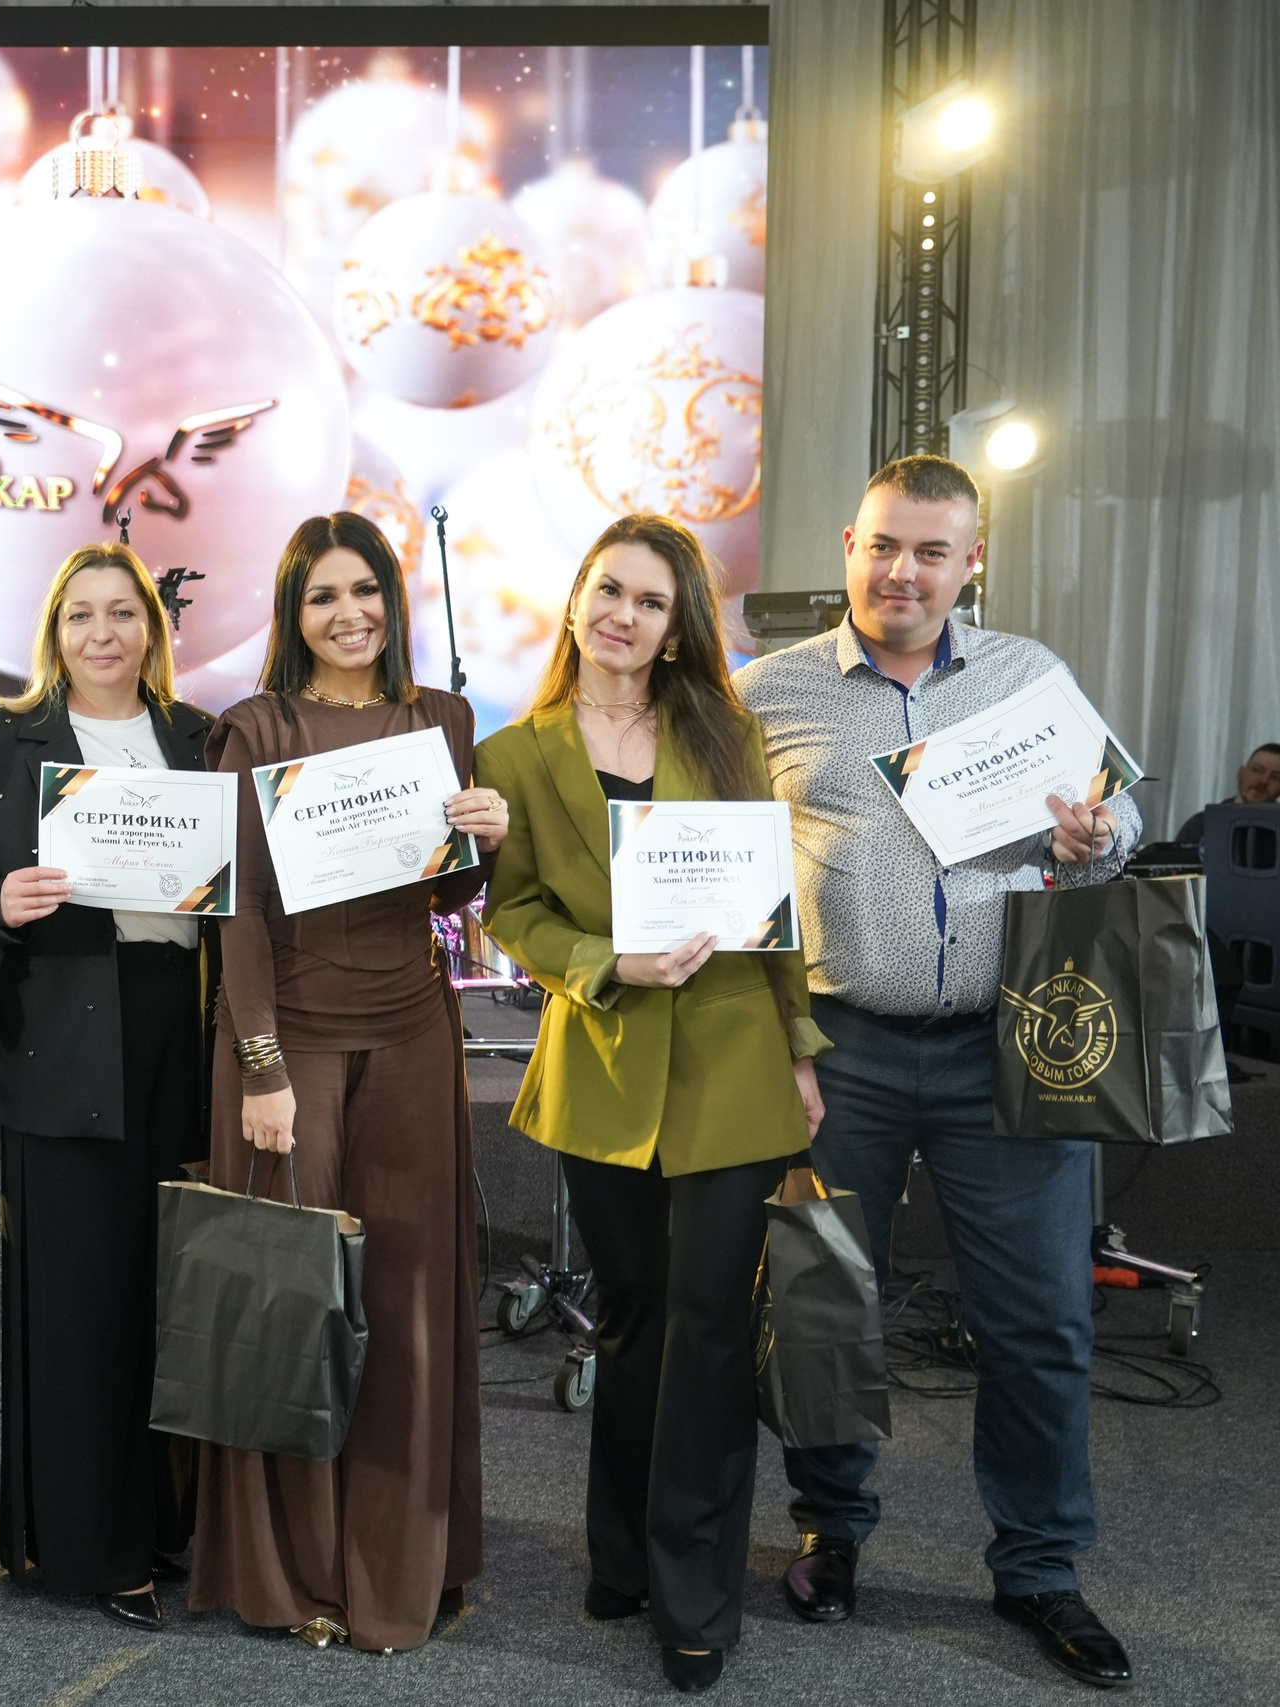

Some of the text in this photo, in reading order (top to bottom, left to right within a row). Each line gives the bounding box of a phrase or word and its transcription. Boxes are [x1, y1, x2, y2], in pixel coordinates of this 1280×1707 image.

[928, 724, 1057, 791] СЕРТИФИКАТ
[956, 753, 1054, 800] Xiaomi Air Fryer 6,5 L
[969, 757, 1029, 787] на аэрогриль
[294, 780, 421, 821] СЕРТИФИКАТ
[74, 812, 200, 830] СЕРТИФИКАТ
[343, 805, 389, 822] аэрогриль
[316, 808, 411, 838] Xiaomi Air Fryer 6,5 L
[91, 836, 120, 845] Xiaomi
[139, 839, 160, 848] Fryer
[120, 830, 165, 838] аэрогриль
[104, 855, 139, 869] Мария
[636, 850, 754, 864] СЕРТИФИКАТ
[681, 867, 725, 875] аэрогриль
[700, 876, 721, 884] Fryer
[1046, 980, 1084, 1000] ANKAR
[1067, 1035, 1109, 1080] ГОДОМ!
[1038, 1094, 1096, 1102] WWW.ANKAR.BY
